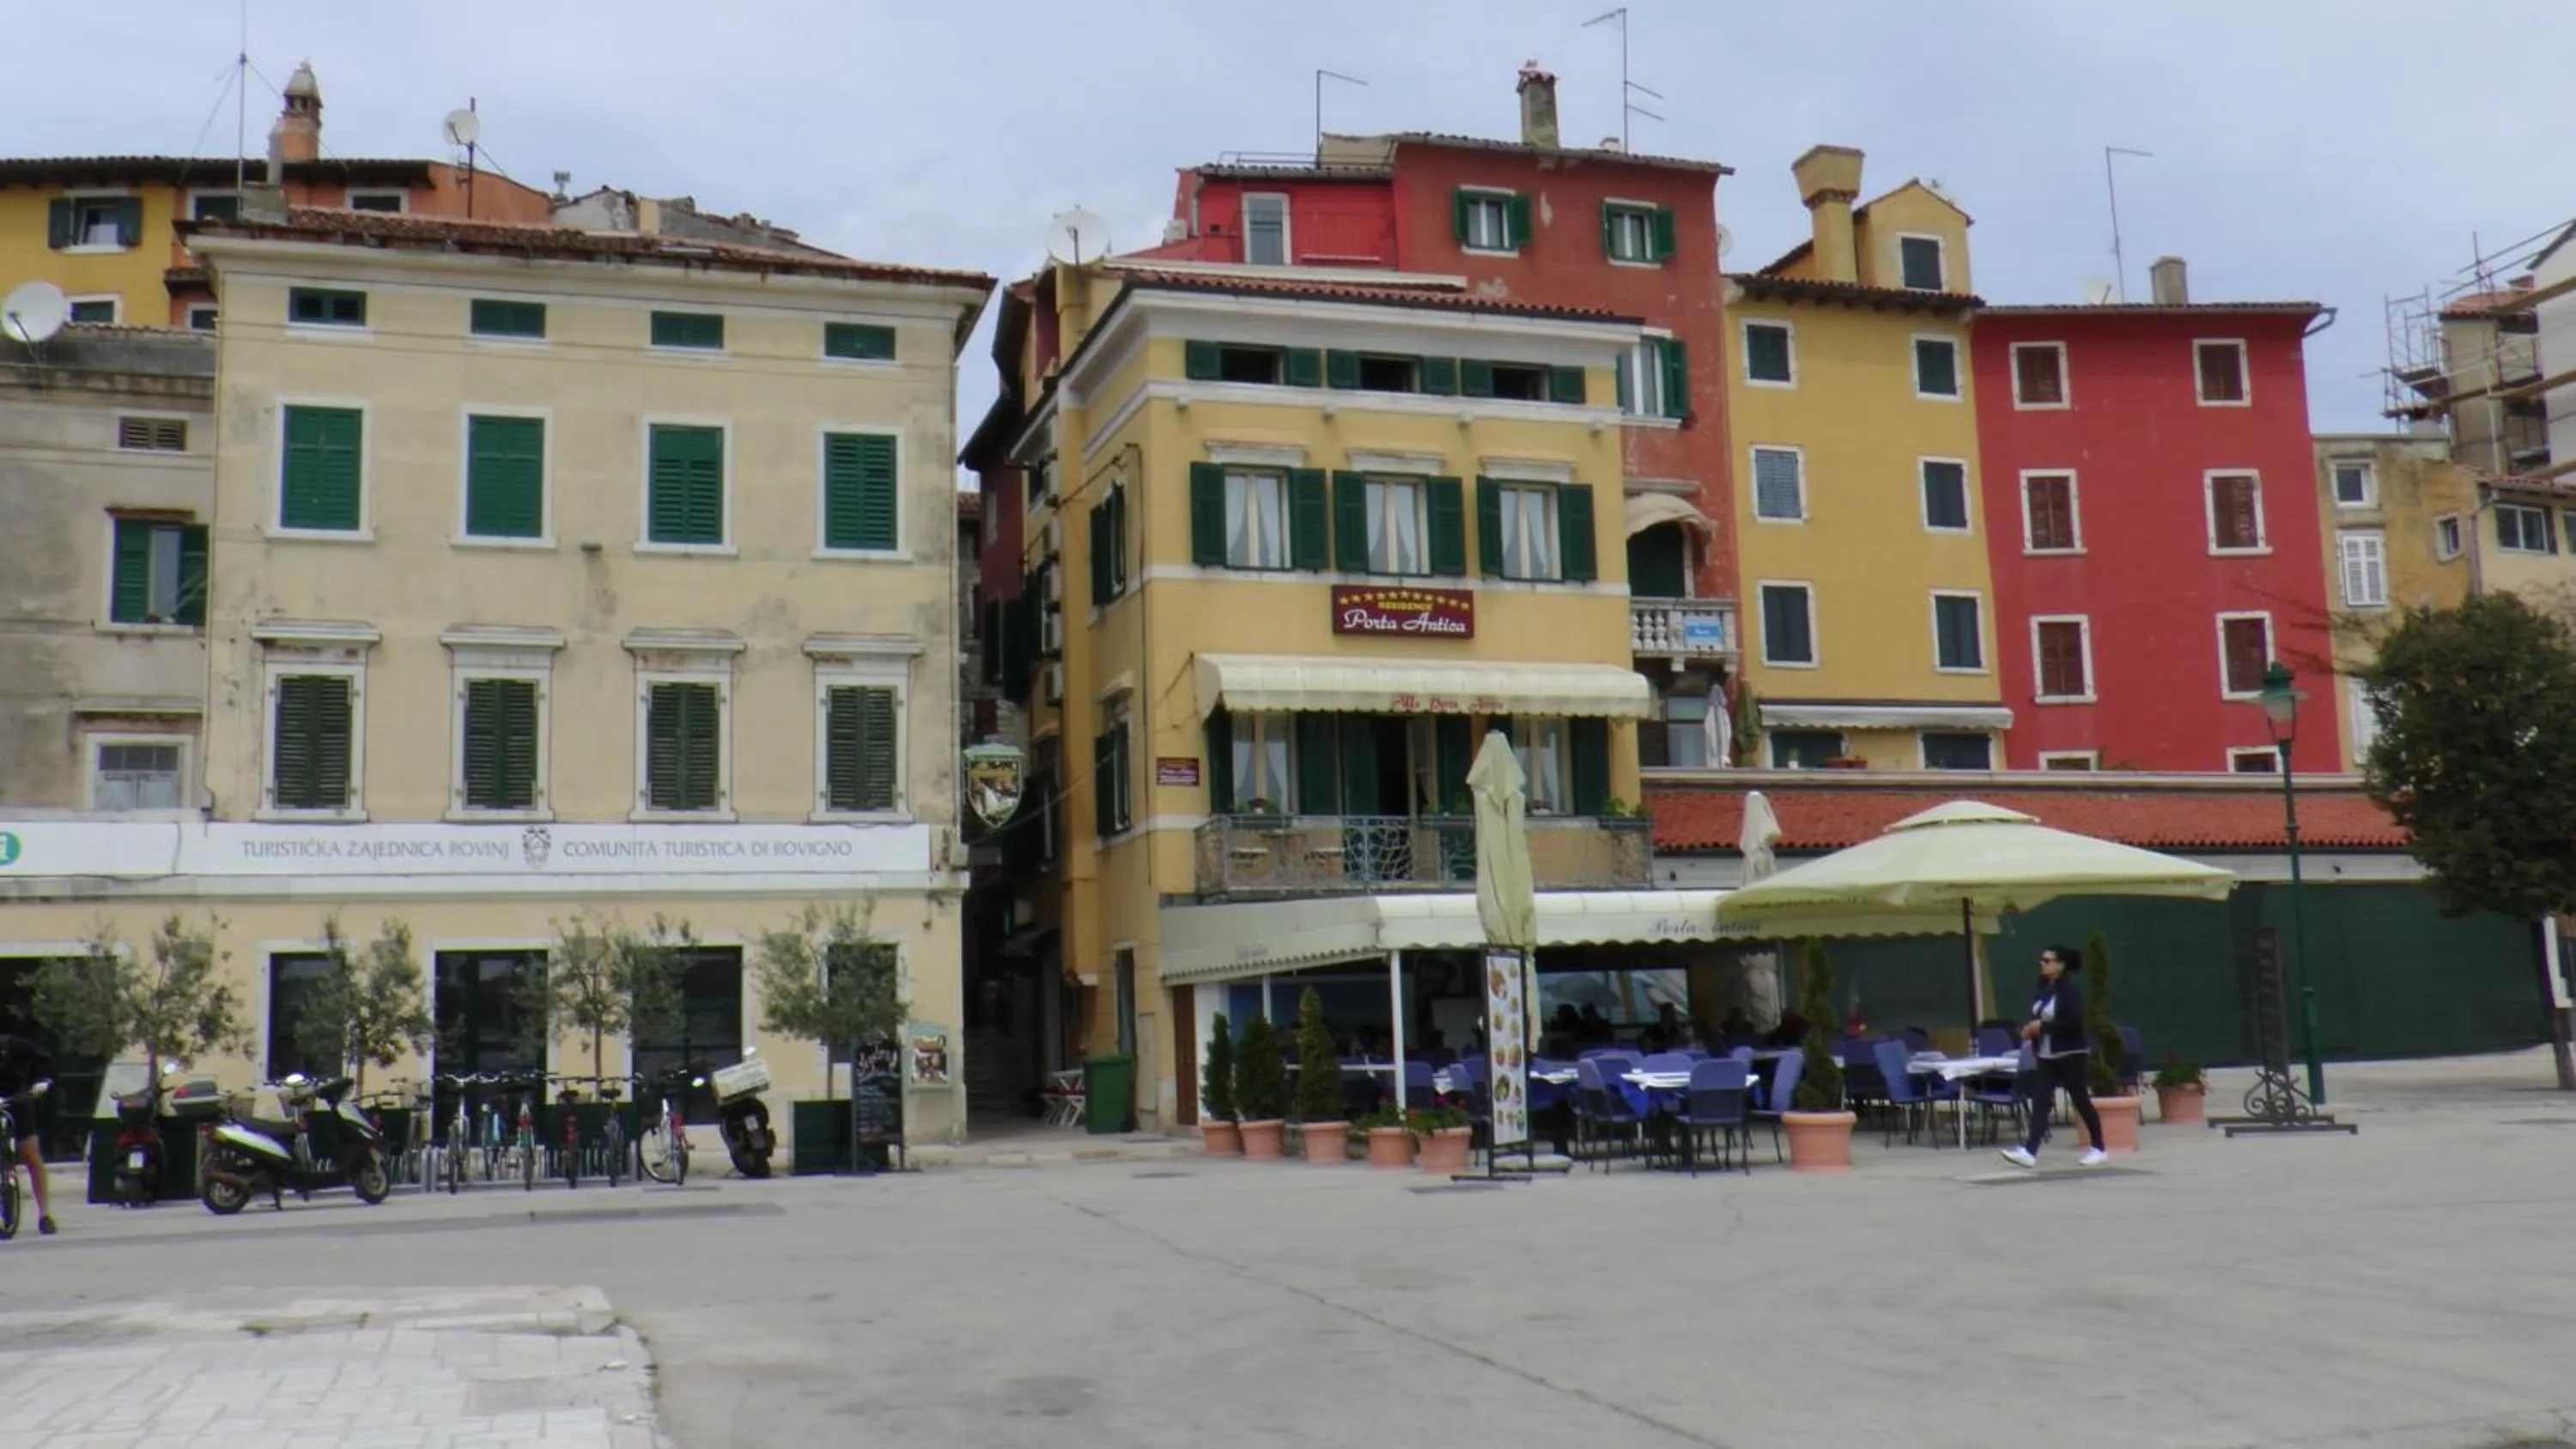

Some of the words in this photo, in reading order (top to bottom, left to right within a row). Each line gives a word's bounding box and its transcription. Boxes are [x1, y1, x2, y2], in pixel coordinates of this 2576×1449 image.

[1343, 608, 1398, 629] Porta
[1402, 610, 1466, 633] Antica
[347, 841, 443, 859] ZAJEDNICA
[450, 841, 510, 859] ROVINJ
[663, 840, 746, 858] TURISTICA
[751, 840, 769, 857] DI
[774, 840, 854, 857] ROVIGNO
